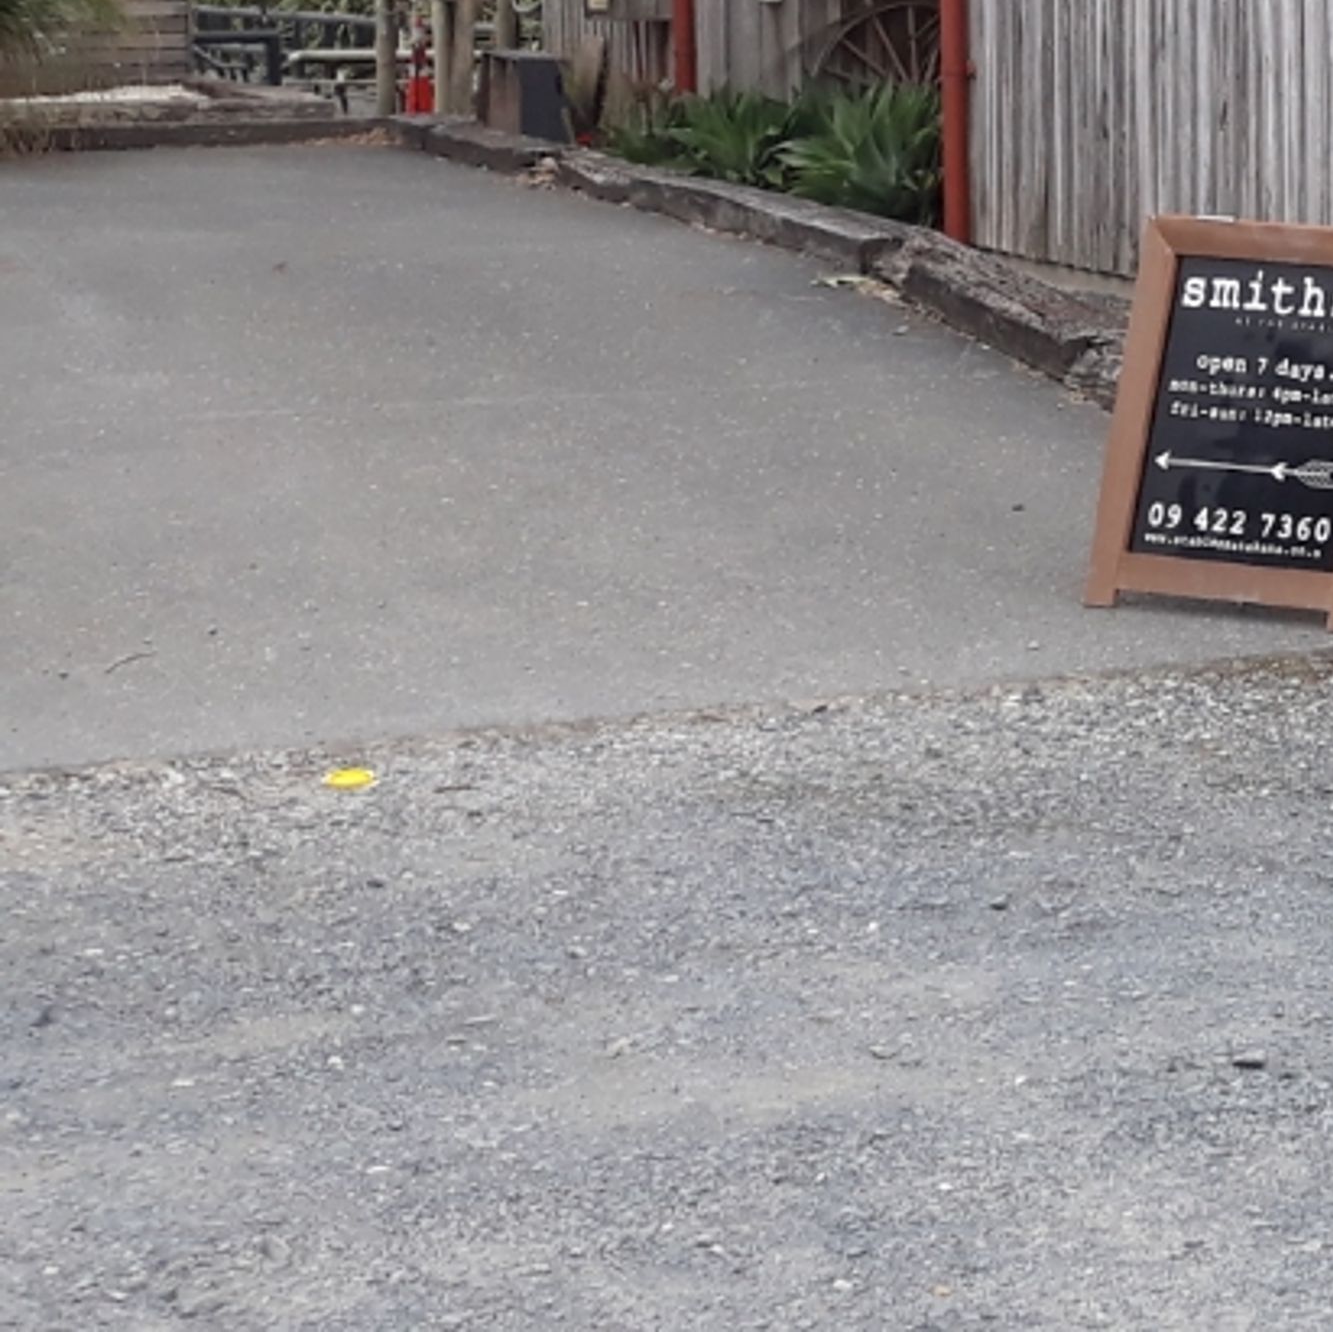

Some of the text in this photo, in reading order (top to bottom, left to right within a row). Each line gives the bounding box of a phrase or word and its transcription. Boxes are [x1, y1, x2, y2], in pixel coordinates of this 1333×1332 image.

[1196, 354, 1248, 375] open
[1257, 357, 1269, 376] 7
[1147, 501, 1332, 543] 09 422 7360
